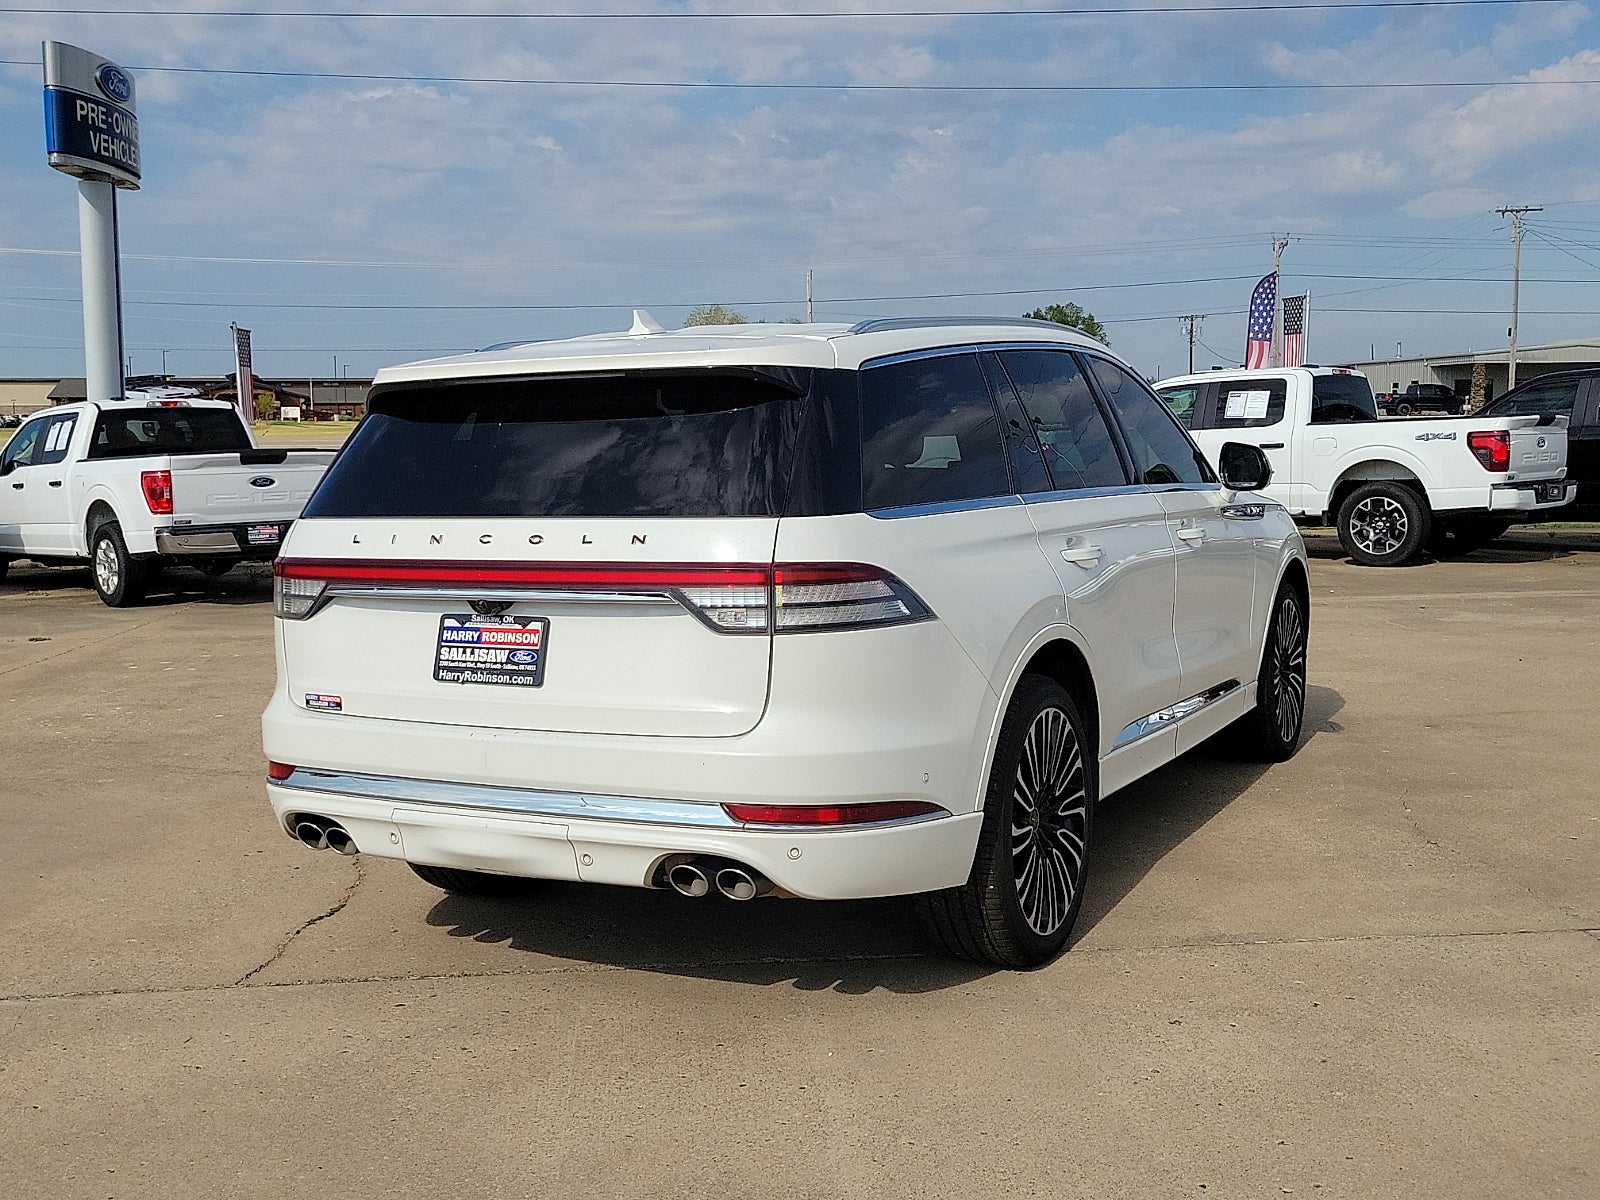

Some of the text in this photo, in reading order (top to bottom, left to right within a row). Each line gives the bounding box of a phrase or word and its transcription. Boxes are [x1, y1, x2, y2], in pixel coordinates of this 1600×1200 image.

[107, 69, 129, 98] Ford
[76, 100, 138, 142] PRE-OWNE
[352, 533, 648, 546] LINCOLN
[502, 615, 515, 624] OK
[442, 629, 540, 644] HARRY ROBINSON
[440, 647, 510, 663] SALLISAW
[439, 669, 534, 685] HarryRobinson.com
